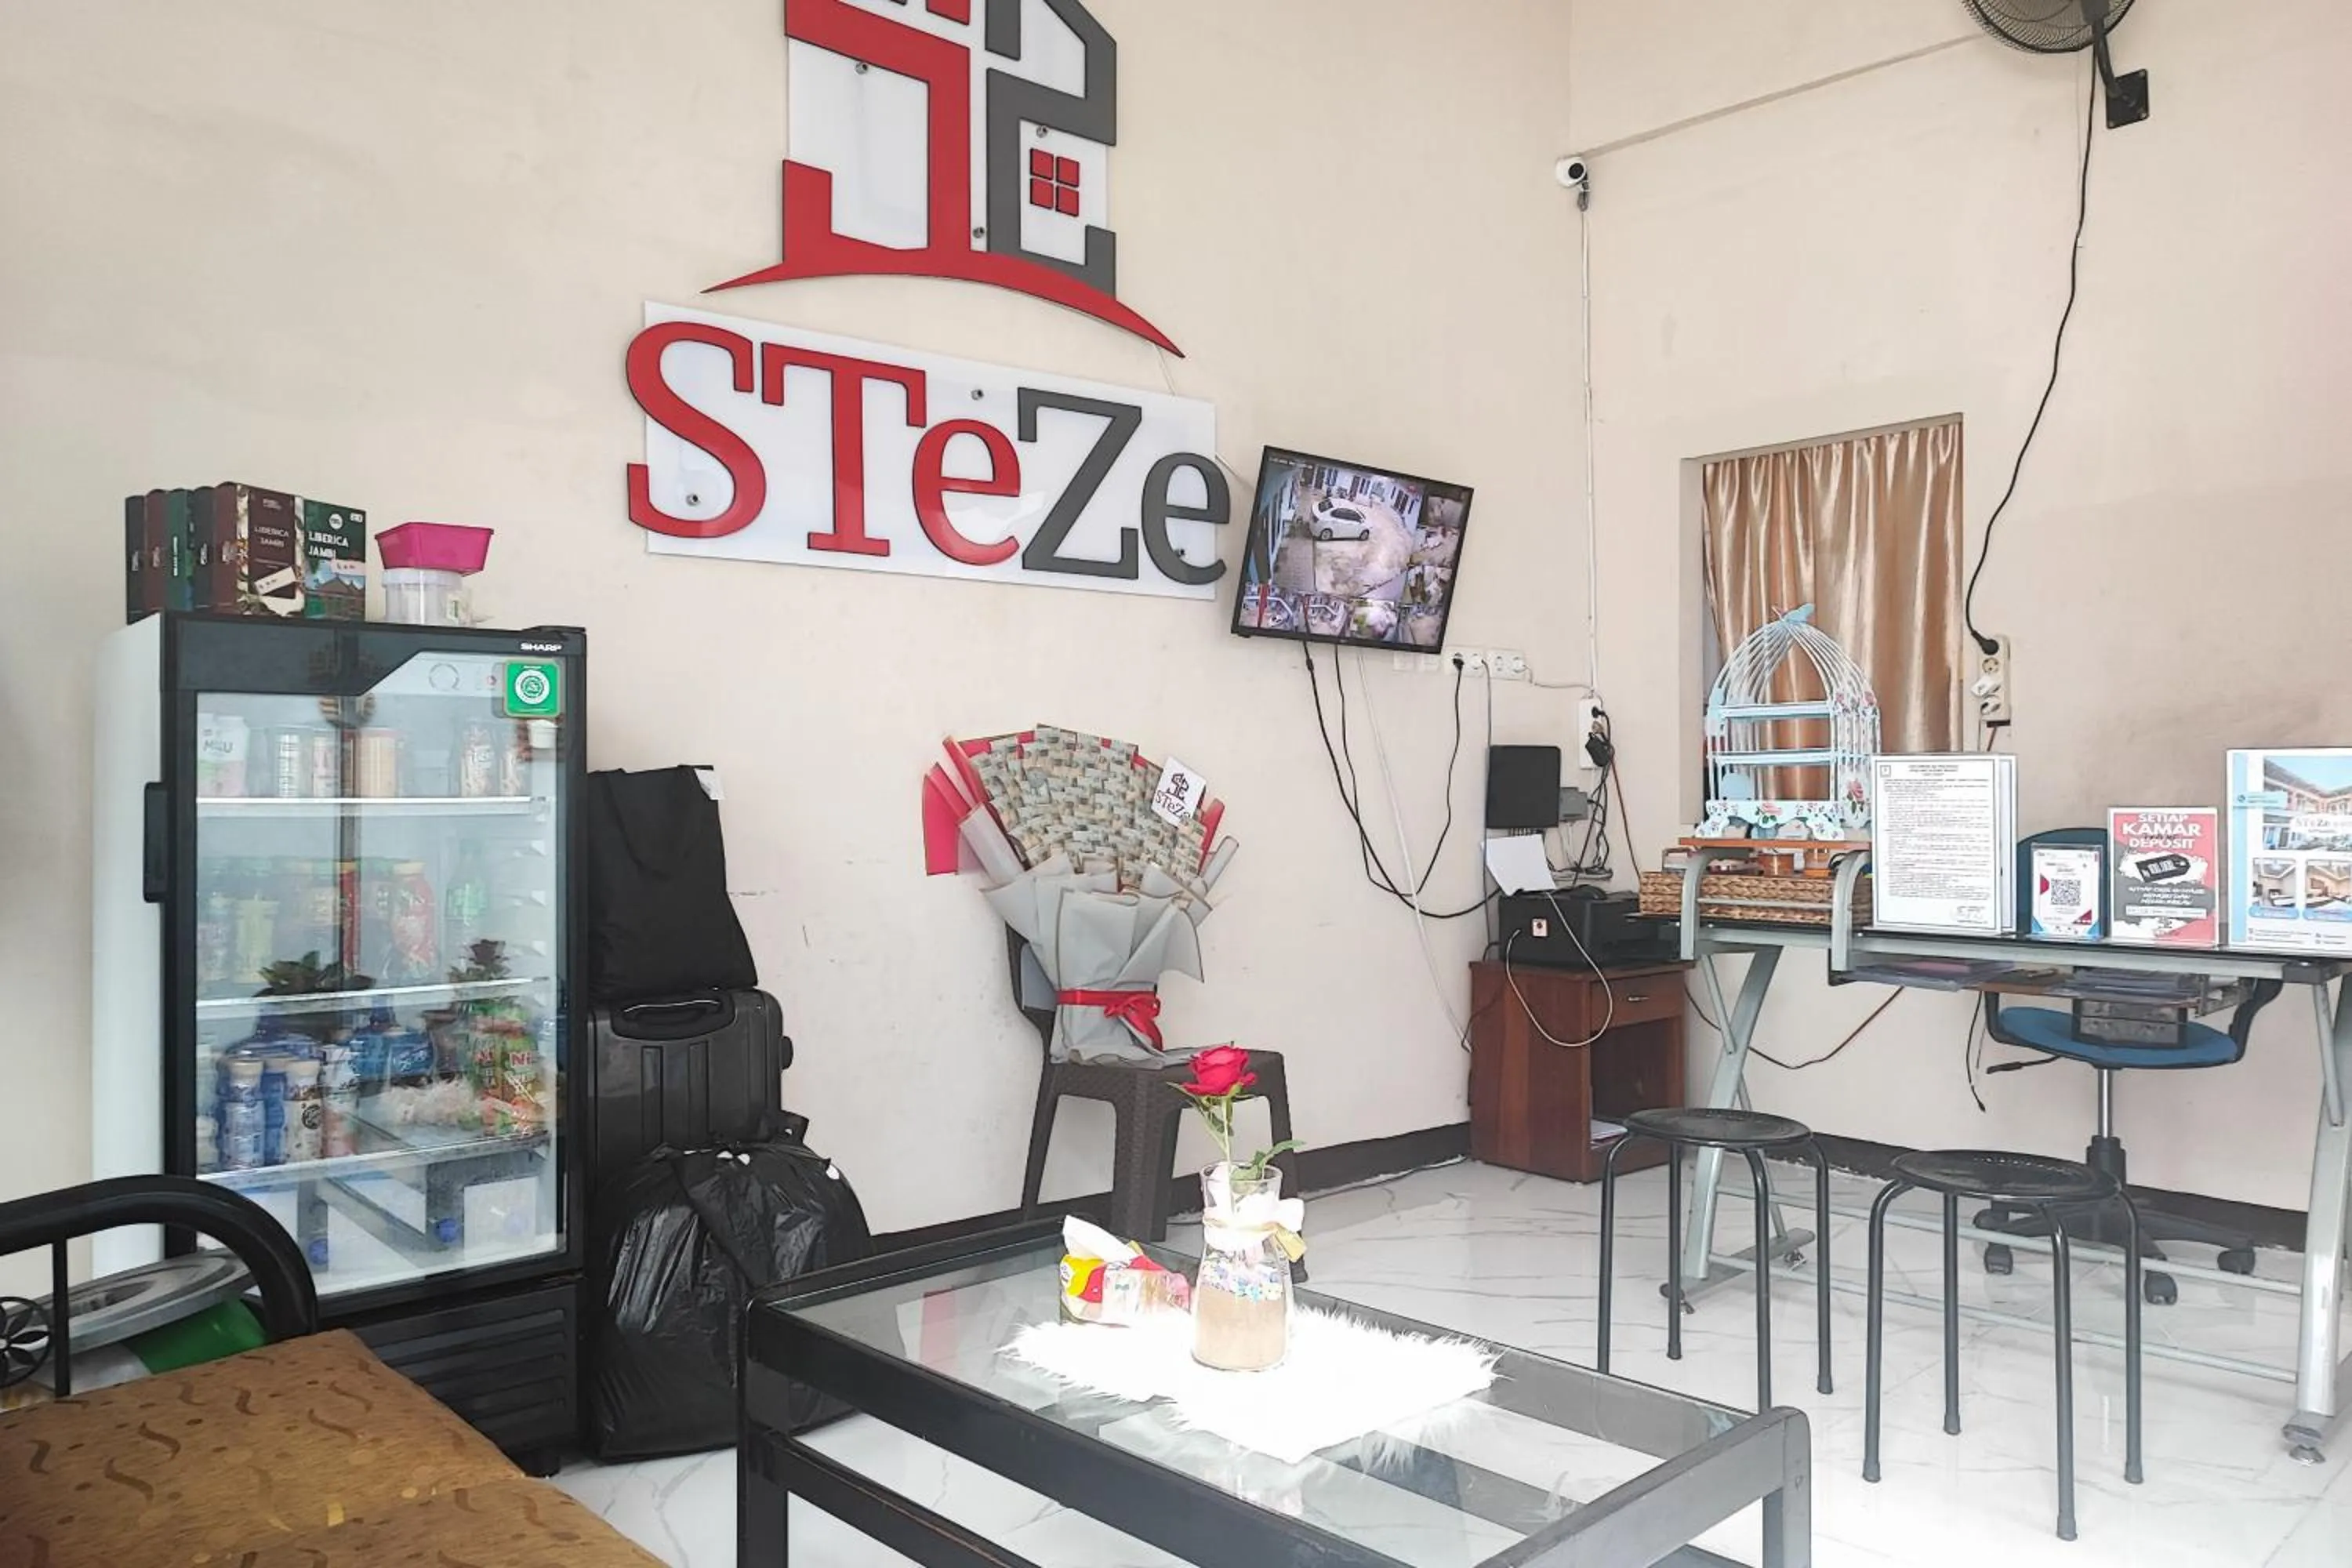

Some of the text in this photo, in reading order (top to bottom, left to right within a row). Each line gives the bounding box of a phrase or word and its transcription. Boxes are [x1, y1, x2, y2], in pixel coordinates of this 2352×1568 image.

[626, 321, 1230, 586] STeZe
[308, 531, 349, 547] LIBERICA
[308, 545, 336, 559] JAMBI
[520, 642, 562, 652] SHARP
[2137, 813, 2190, 822] SETIAP
[2122, 822, 2202, 837] KAMAR
[2129, 837, 2196, 849] DEPOSIT
